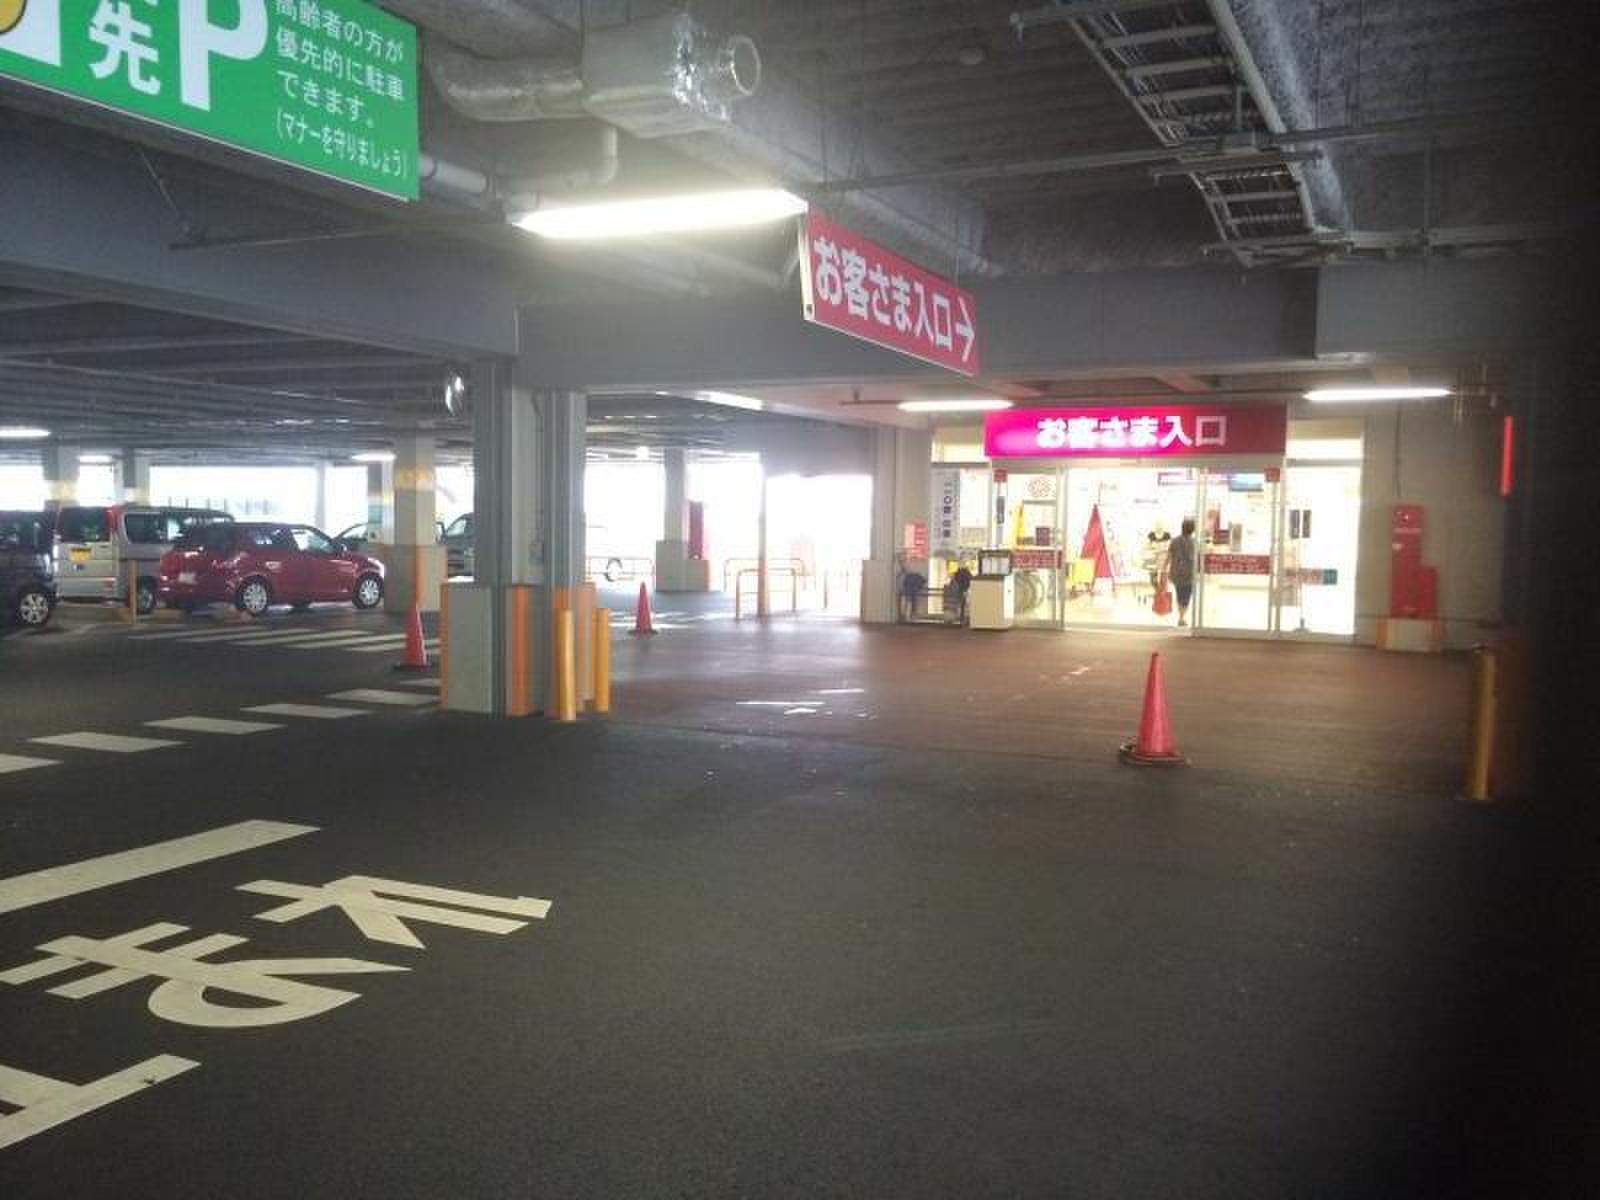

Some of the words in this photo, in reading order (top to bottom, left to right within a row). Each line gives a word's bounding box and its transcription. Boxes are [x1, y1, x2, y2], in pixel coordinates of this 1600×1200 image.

[178, 0, 268, 112] P
[277, 27, 404, 101] 優先的に駐車
[814, 237, 952, 351] お客さま入口
[1037, 416, 1226, 447] お客さま入口
